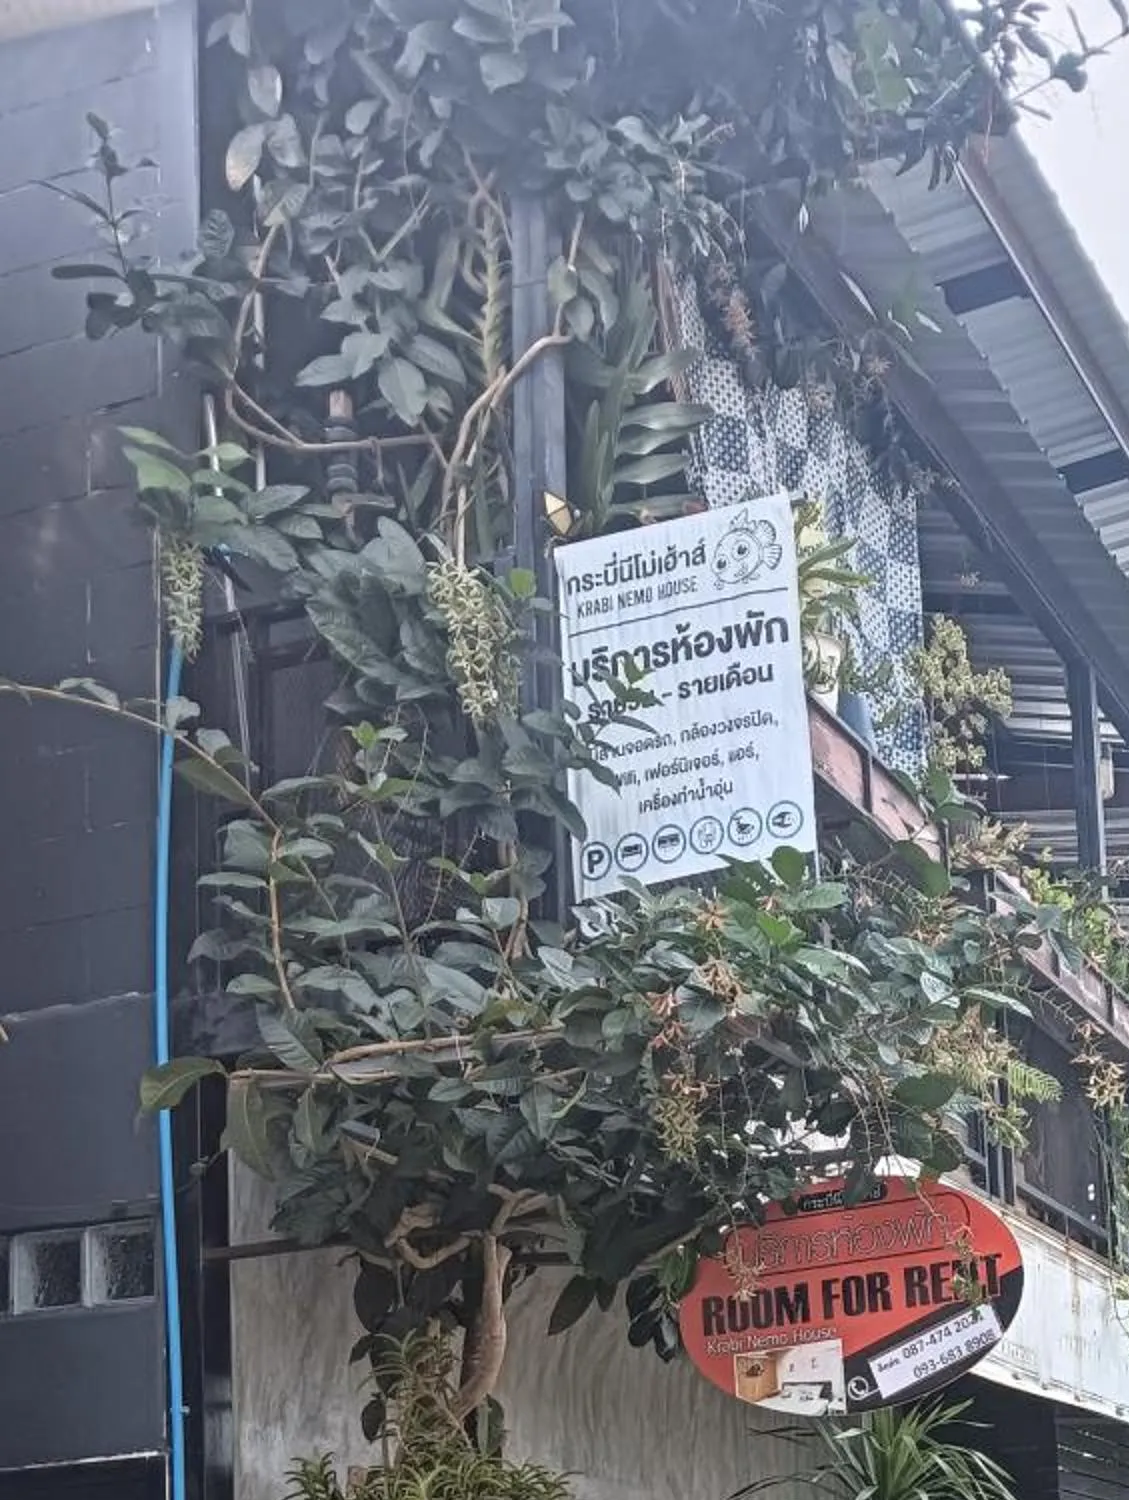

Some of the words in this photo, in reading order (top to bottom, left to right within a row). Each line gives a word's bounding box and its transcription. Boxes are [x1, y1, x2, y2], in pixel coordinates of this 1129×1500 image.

[577, 594, 614, 619] KRABI
[618, 587, 653, 611] NEMO
[658, 576, 698, 601] HOUSE
[678, 662, 774, 700] รายเดือน
[702, 1281, 812, 1337] ROOM
[822, 1271, 893, 1320] FOR
[707, 1336, 746, 1354] Krabi
[747, 1333, 789, 1349] Nemo
[793, 1327, 837, 1343] House
[902, 1326, 953, 1360] 087-474
